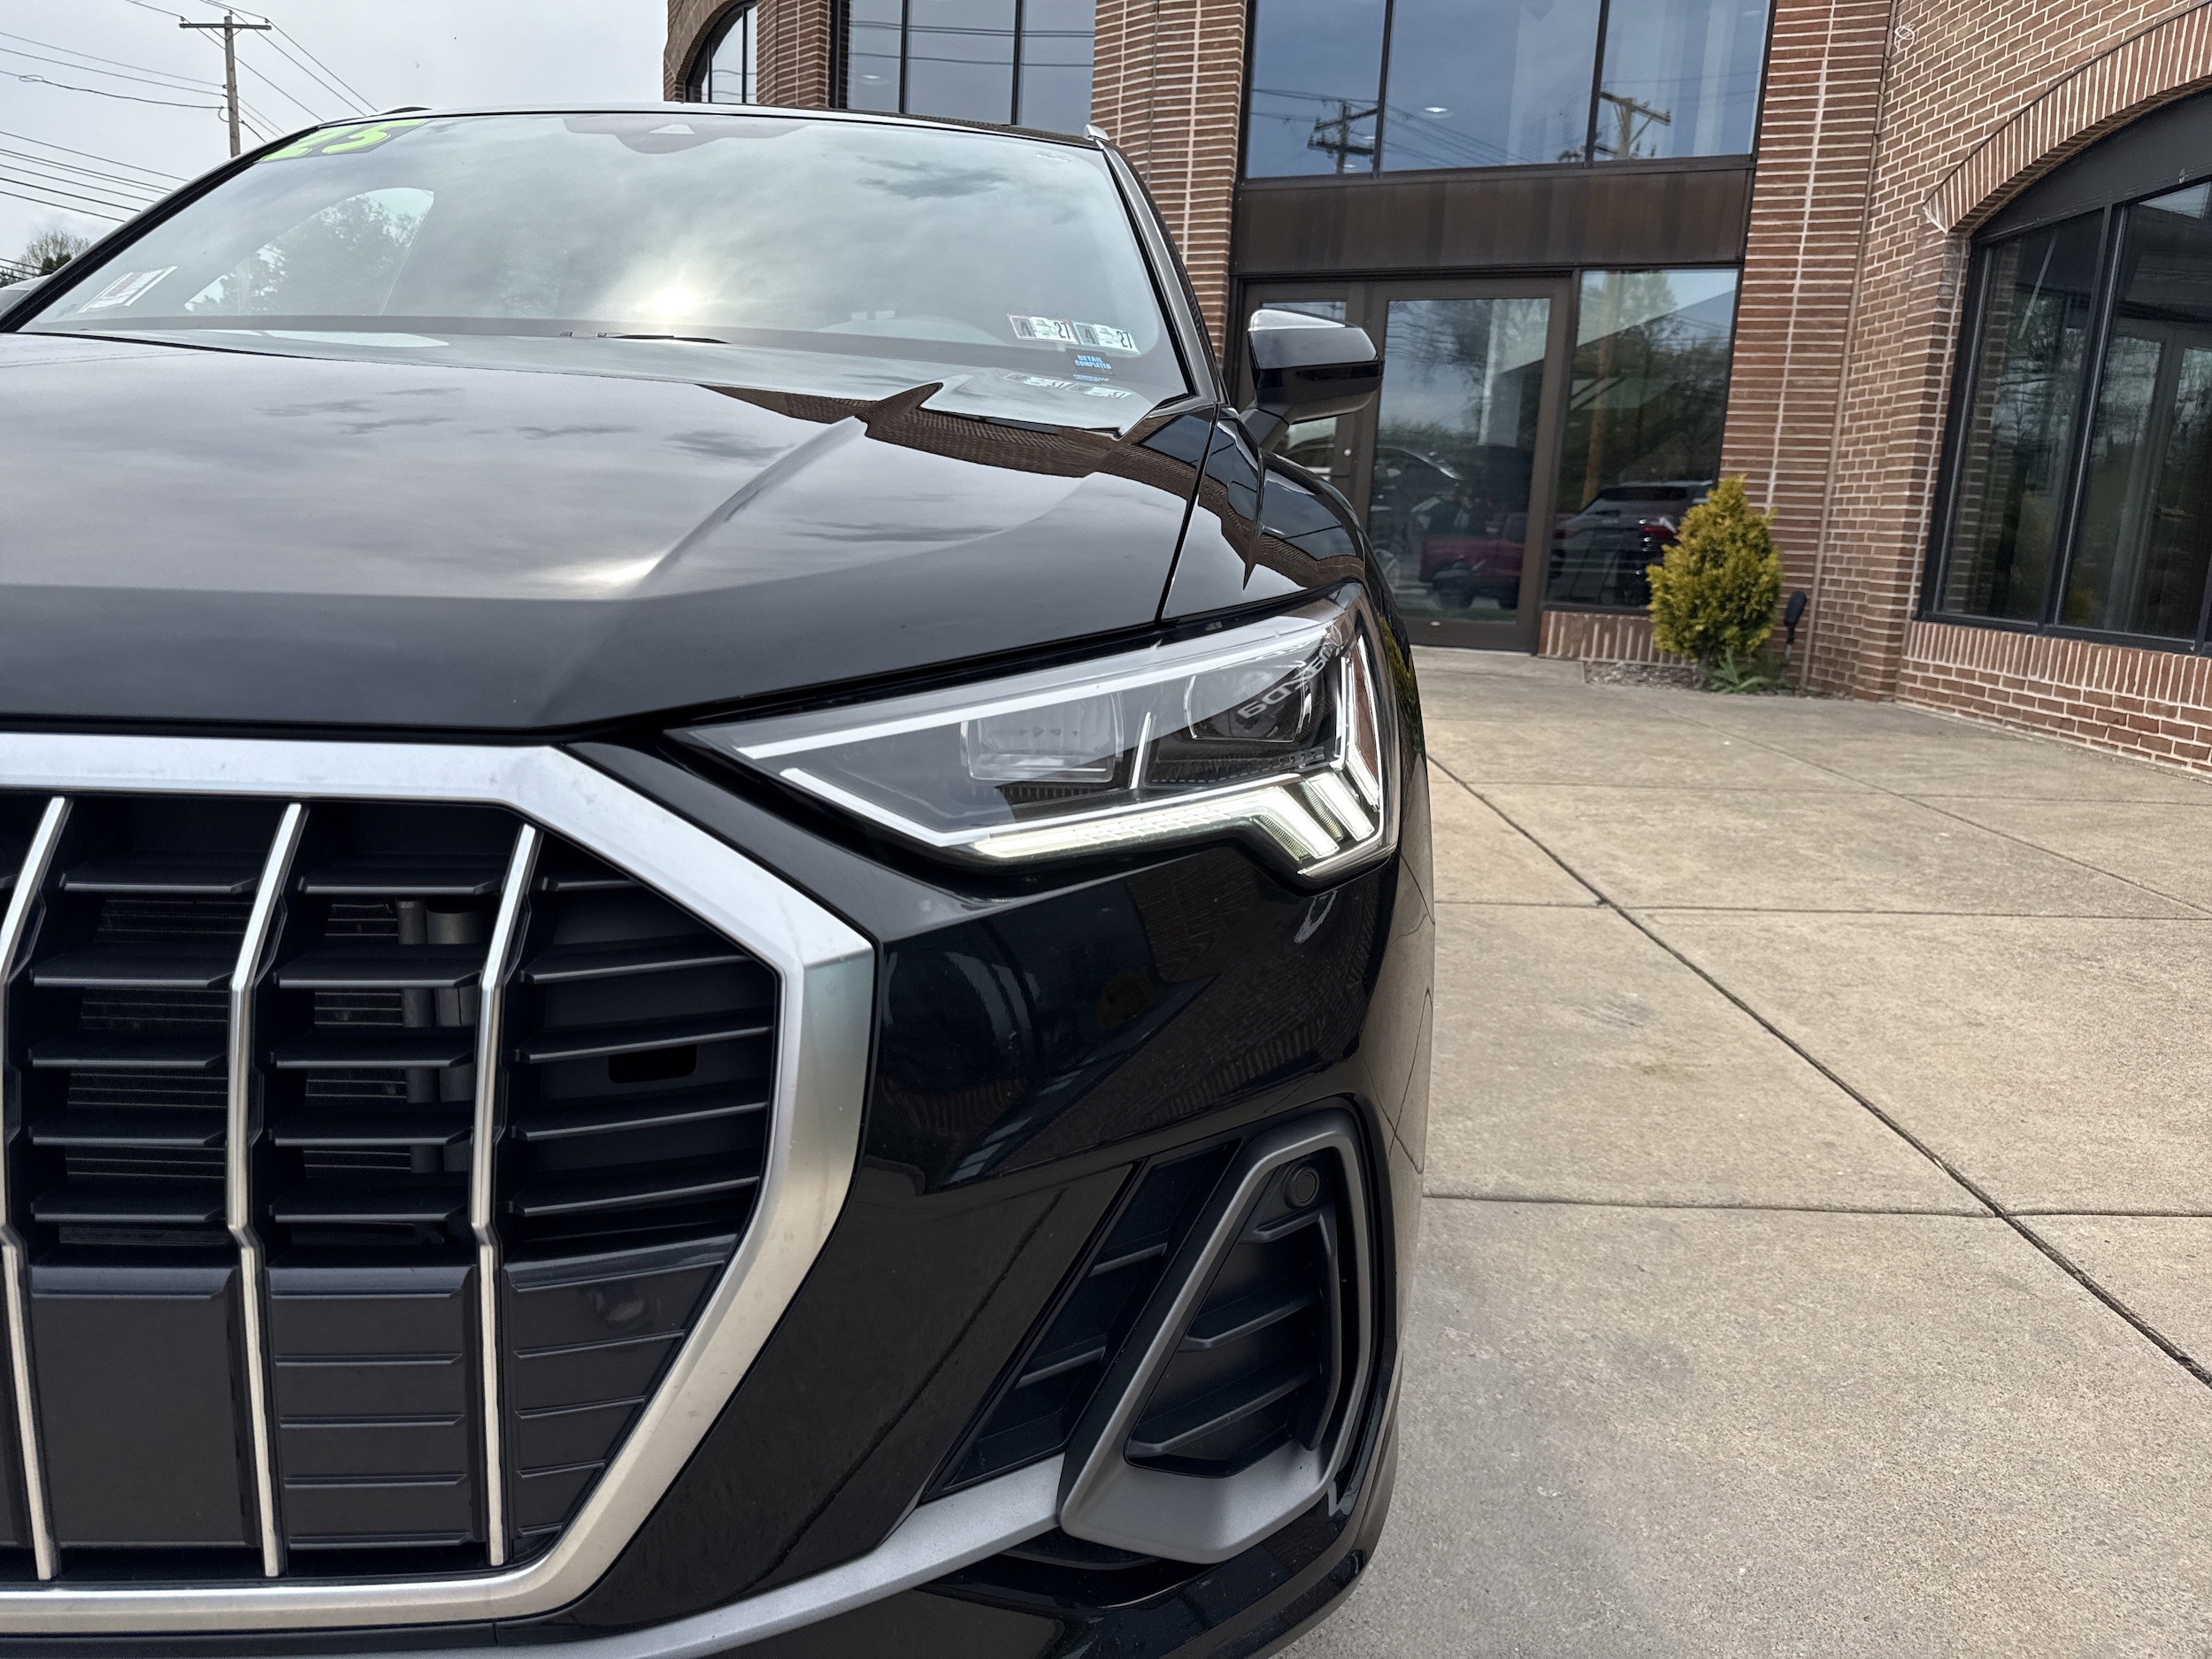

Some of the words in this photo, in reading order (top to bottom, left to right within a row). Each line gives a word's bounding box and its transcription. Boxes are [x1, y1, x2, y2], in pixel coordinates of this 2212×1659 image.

[1053, 321, 1071, 340] 27
[1116, 330, 1133, 349] 27
[1074, 359, 1112, 369] COMPLETED
[1077, 354, 1103, 363] DETAIL
